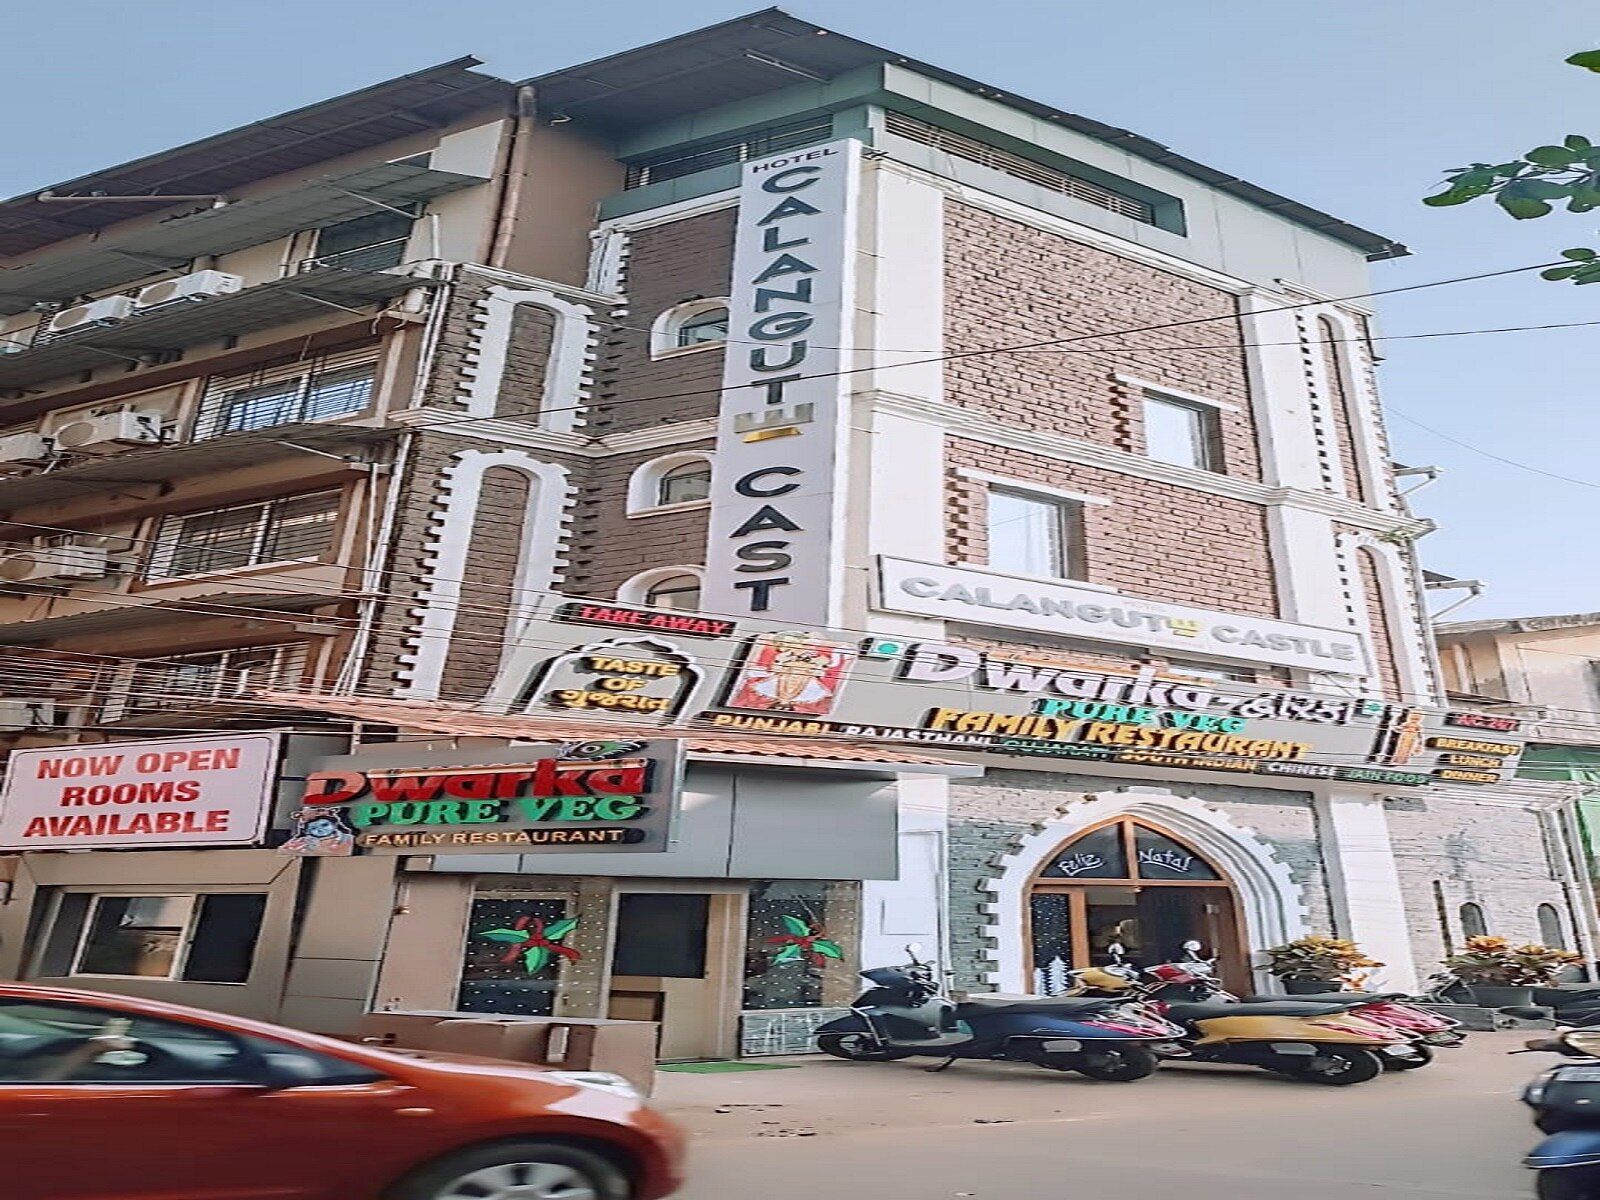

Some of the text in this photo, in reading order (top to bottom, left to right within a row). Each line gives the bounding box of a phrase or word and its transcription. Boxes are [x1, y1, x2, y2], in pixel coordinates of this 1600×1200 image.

[753, 147, 839, 174] HOTEL
[579, 604, 730, 634] TAKE AWAY
[1210, 624, 1355, 661] CASTLE
[591, 657, 681, 676] TASTE
[602, 677, 647, 691] OF
[714, 714, 830, 736] PUNJABI
[1042, 698, 1250, 734] PURE VEG
[845, 726, 992, 746] RAJASTHANI
[931, 707, 1314, 760] FAMILY RESTAURANT
[1436, 738, 1520, 755] BREAKFAST
[37, 747, 241, 779] NOW OPEN
[1267, 761, 1339, 777] CHINESE
[1450, 755, 1499, 768] LUNCH
[302, 757, 648, 804] Dwarka
[1440, 769, 1497, 783] DINNER
[60, 779, 200, 807] ROOMS
[23, 808, 231, 838] AVAILABLE
[355, 794, 643, 826] PURE VEG
[364, 827, 624, 848] FAMILY RESTAURANT
[1058, 848, 1194, 873] Feliz Natal
